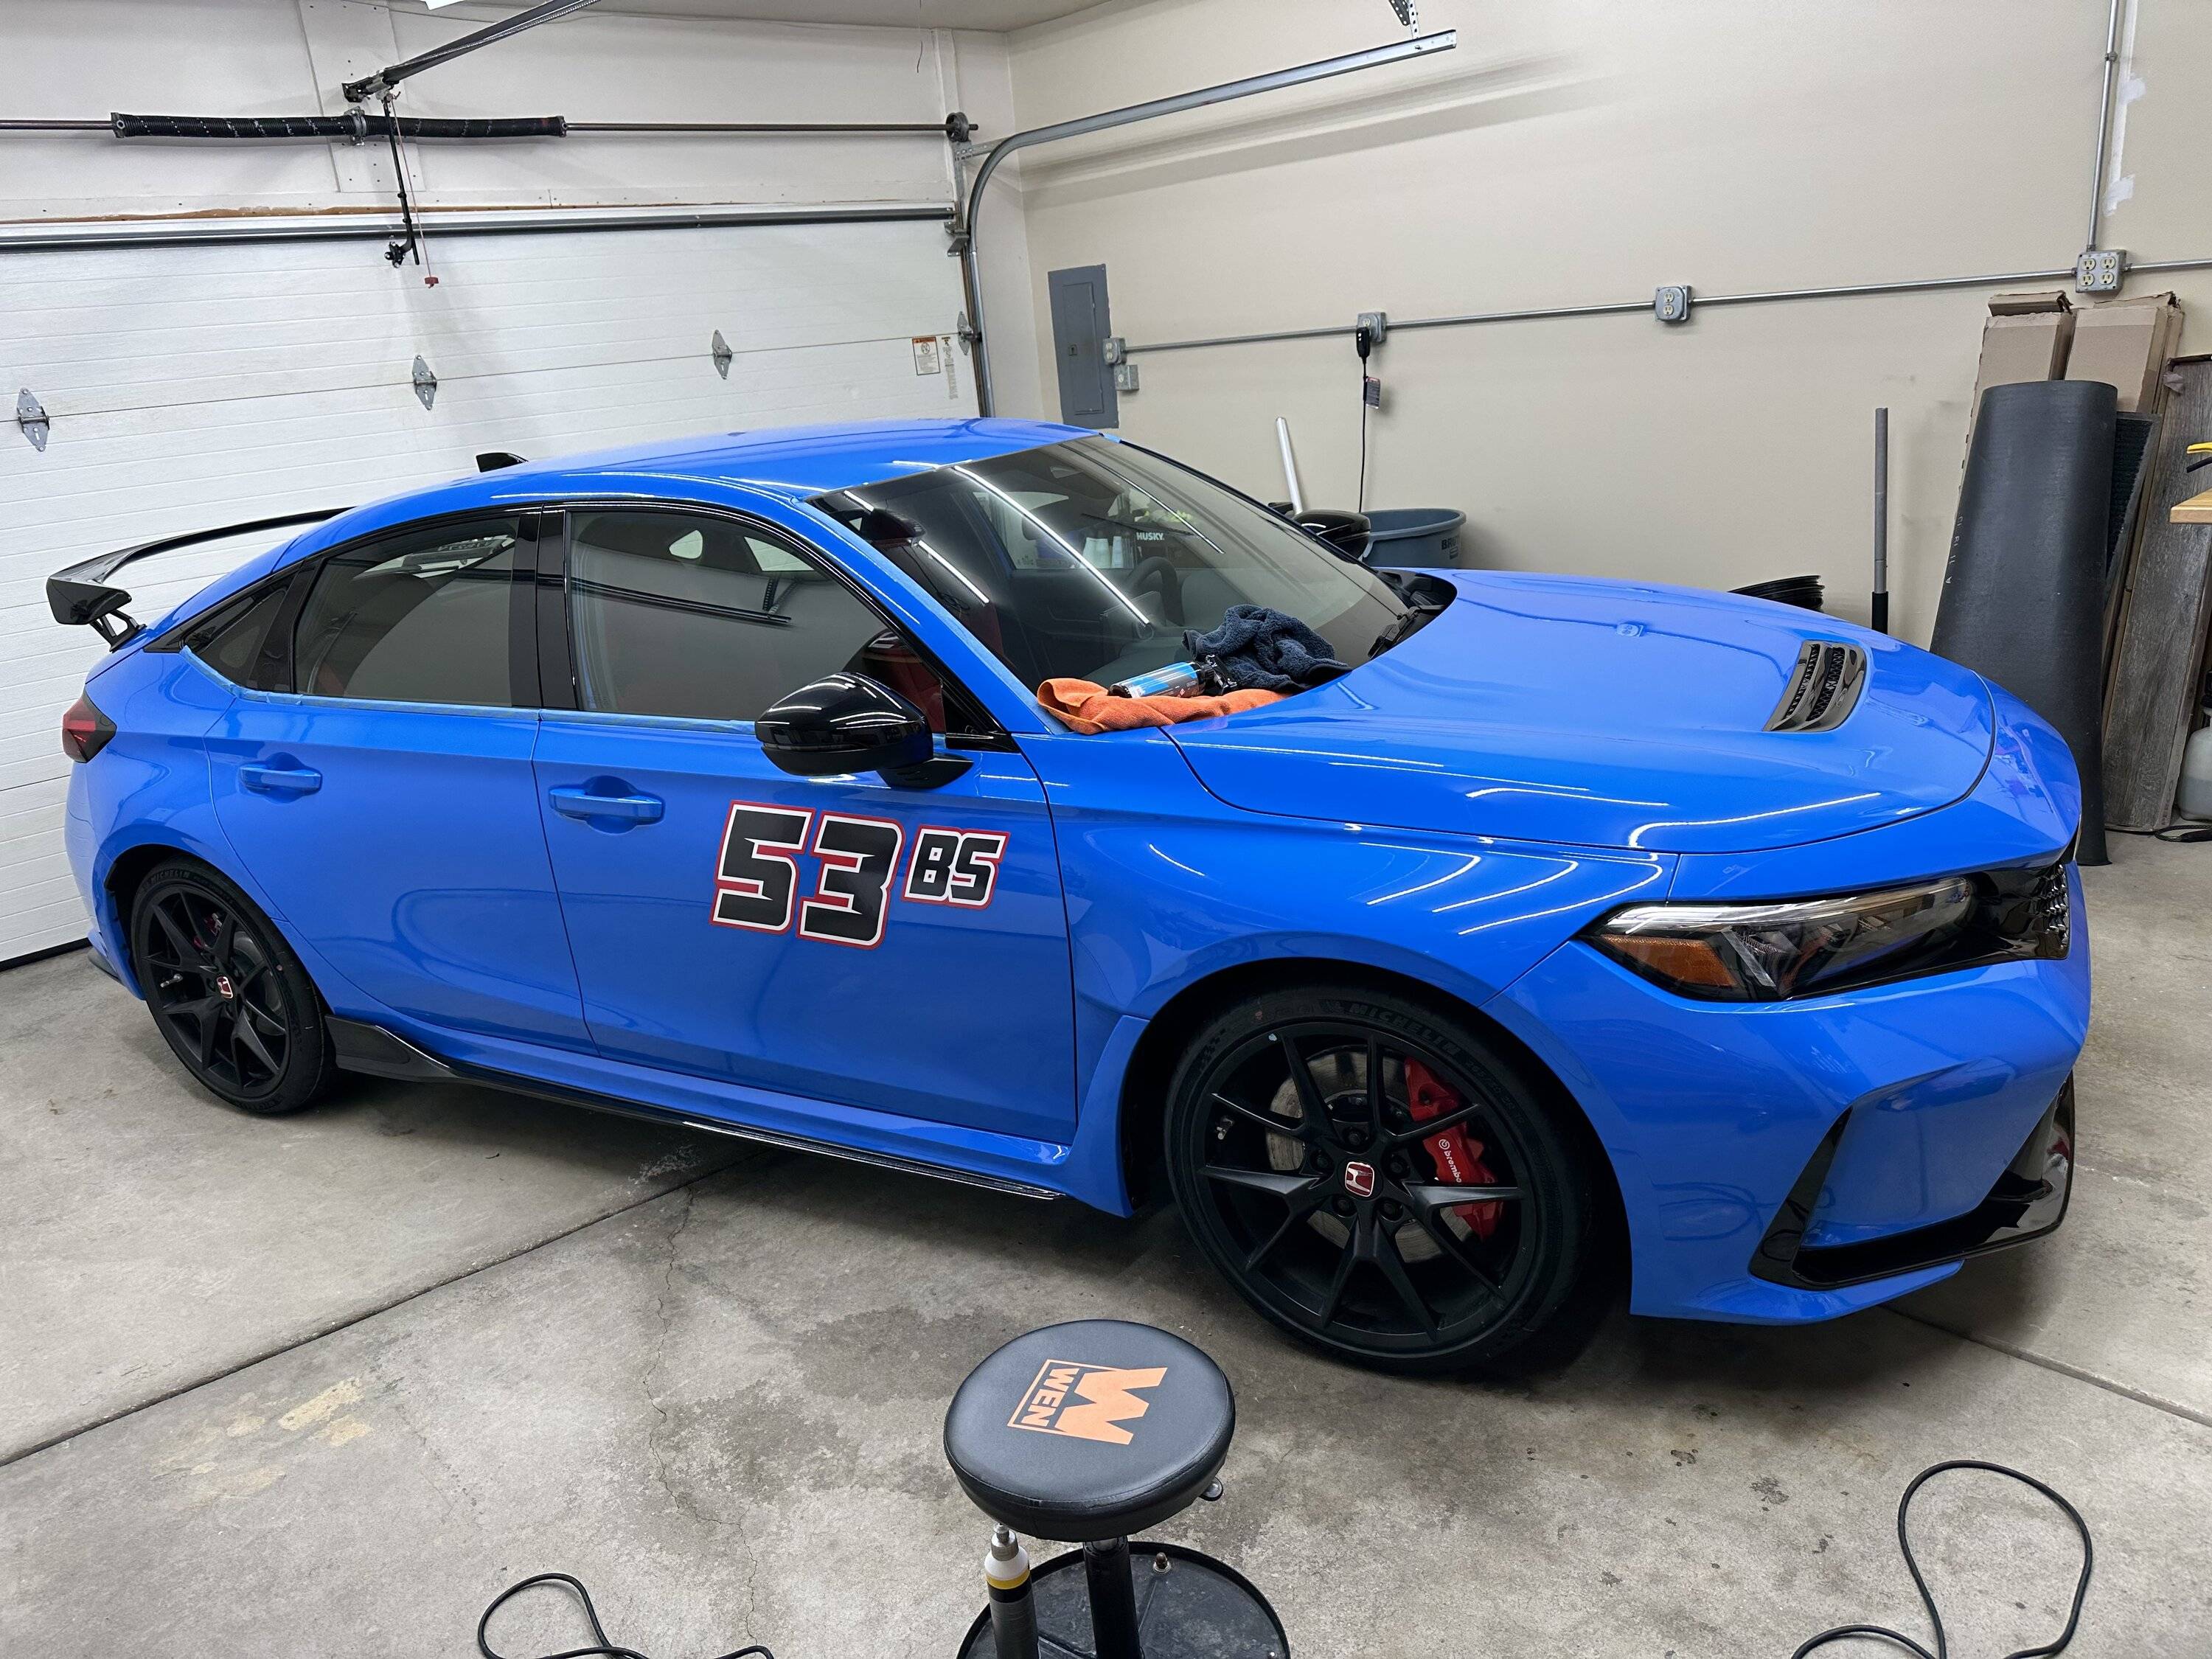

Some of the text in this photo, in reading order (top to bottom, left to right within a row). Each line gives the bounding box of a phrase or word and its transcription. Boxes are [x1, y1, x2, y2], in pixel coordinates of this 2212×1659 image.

[710, 801, 904, 950] 53
[1349, 1001, 1461, 1056] MICHELIN
[1444, 1150, 1461, 1183] brembo
[1020, 1368, 1080, 1427] WEN
